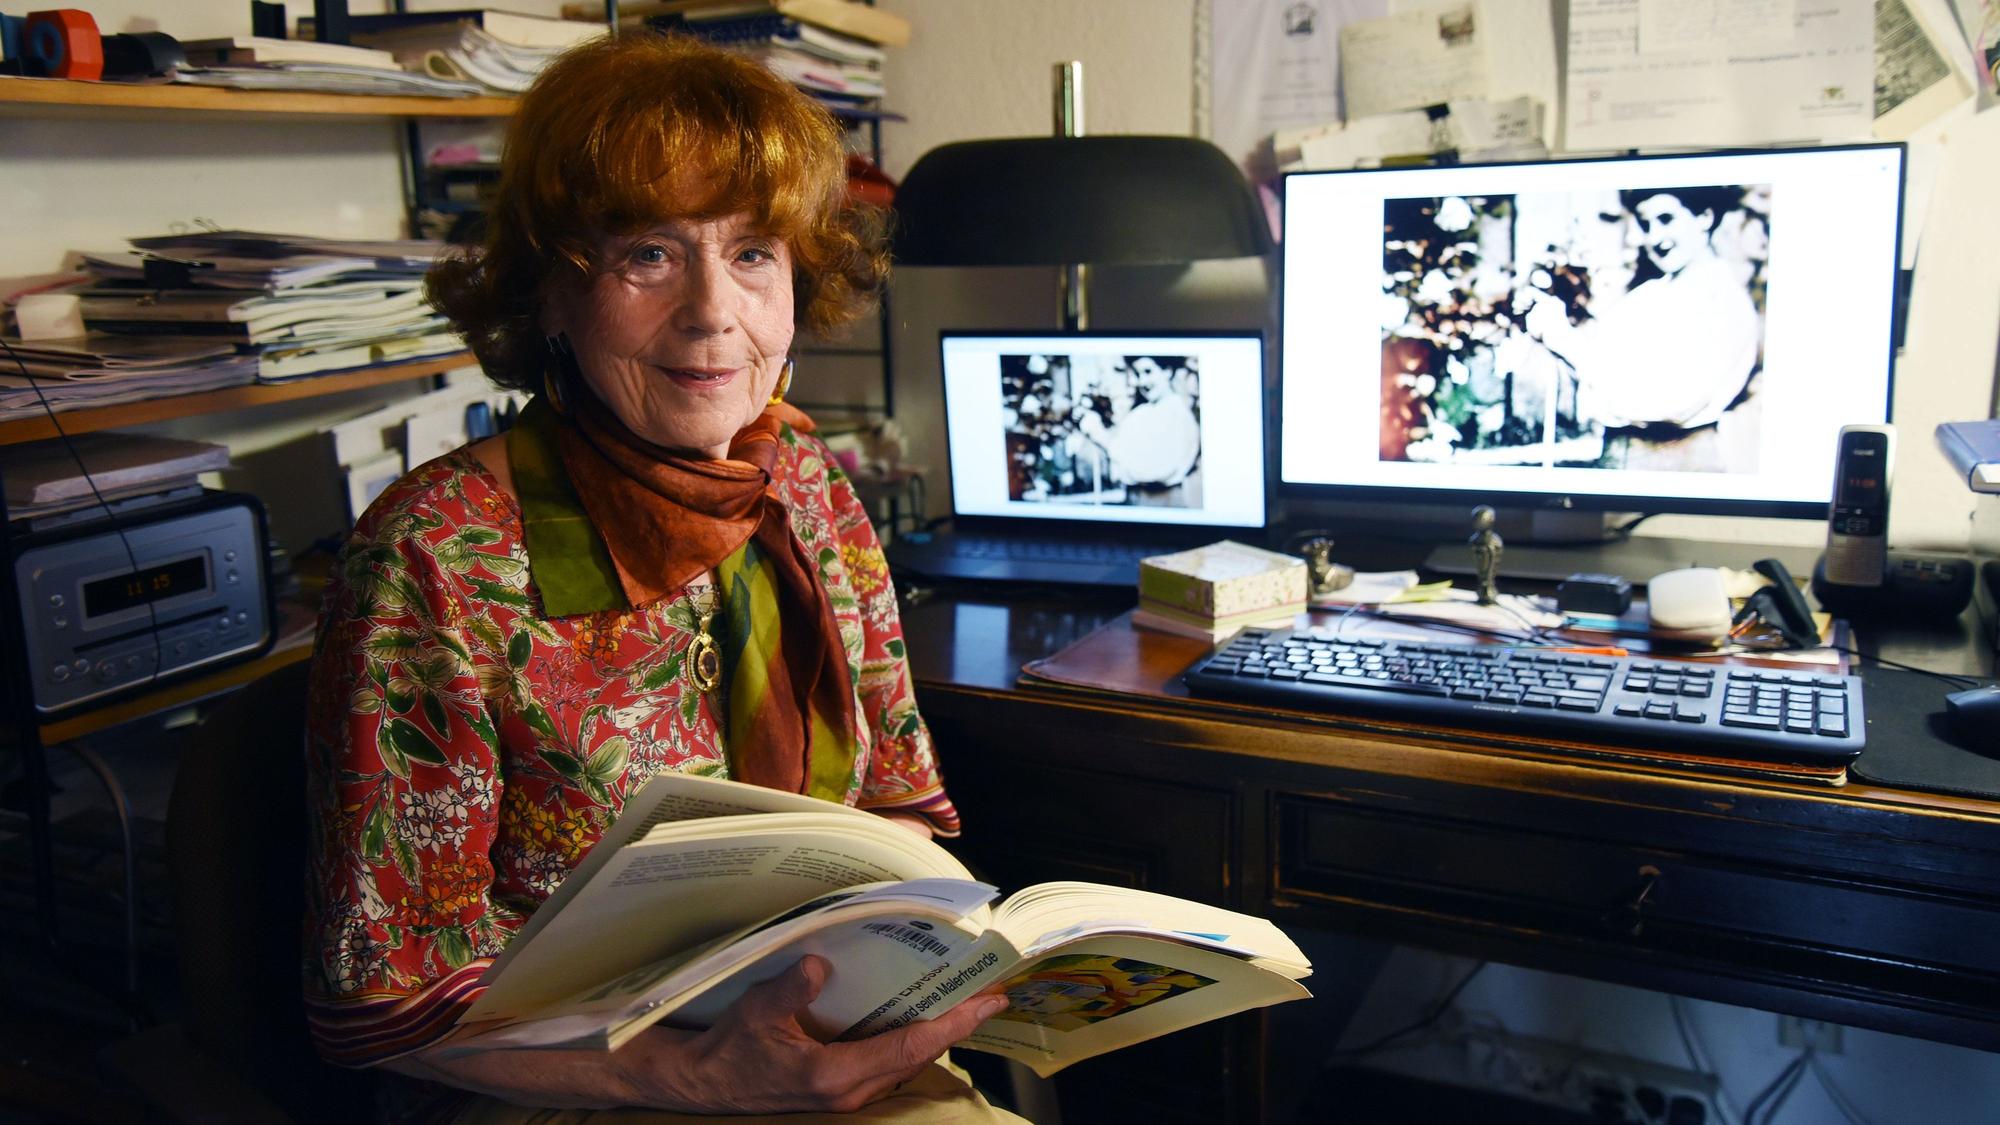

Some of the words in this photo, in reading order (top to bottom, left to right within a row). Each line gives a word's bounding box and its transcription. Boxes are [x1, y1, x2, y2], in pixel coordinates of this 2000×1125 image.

[899, 1004, 919, 1024] und
[915, 991, 942, 1012] seine
[935, 952, 999, 997] Malerfreunde
